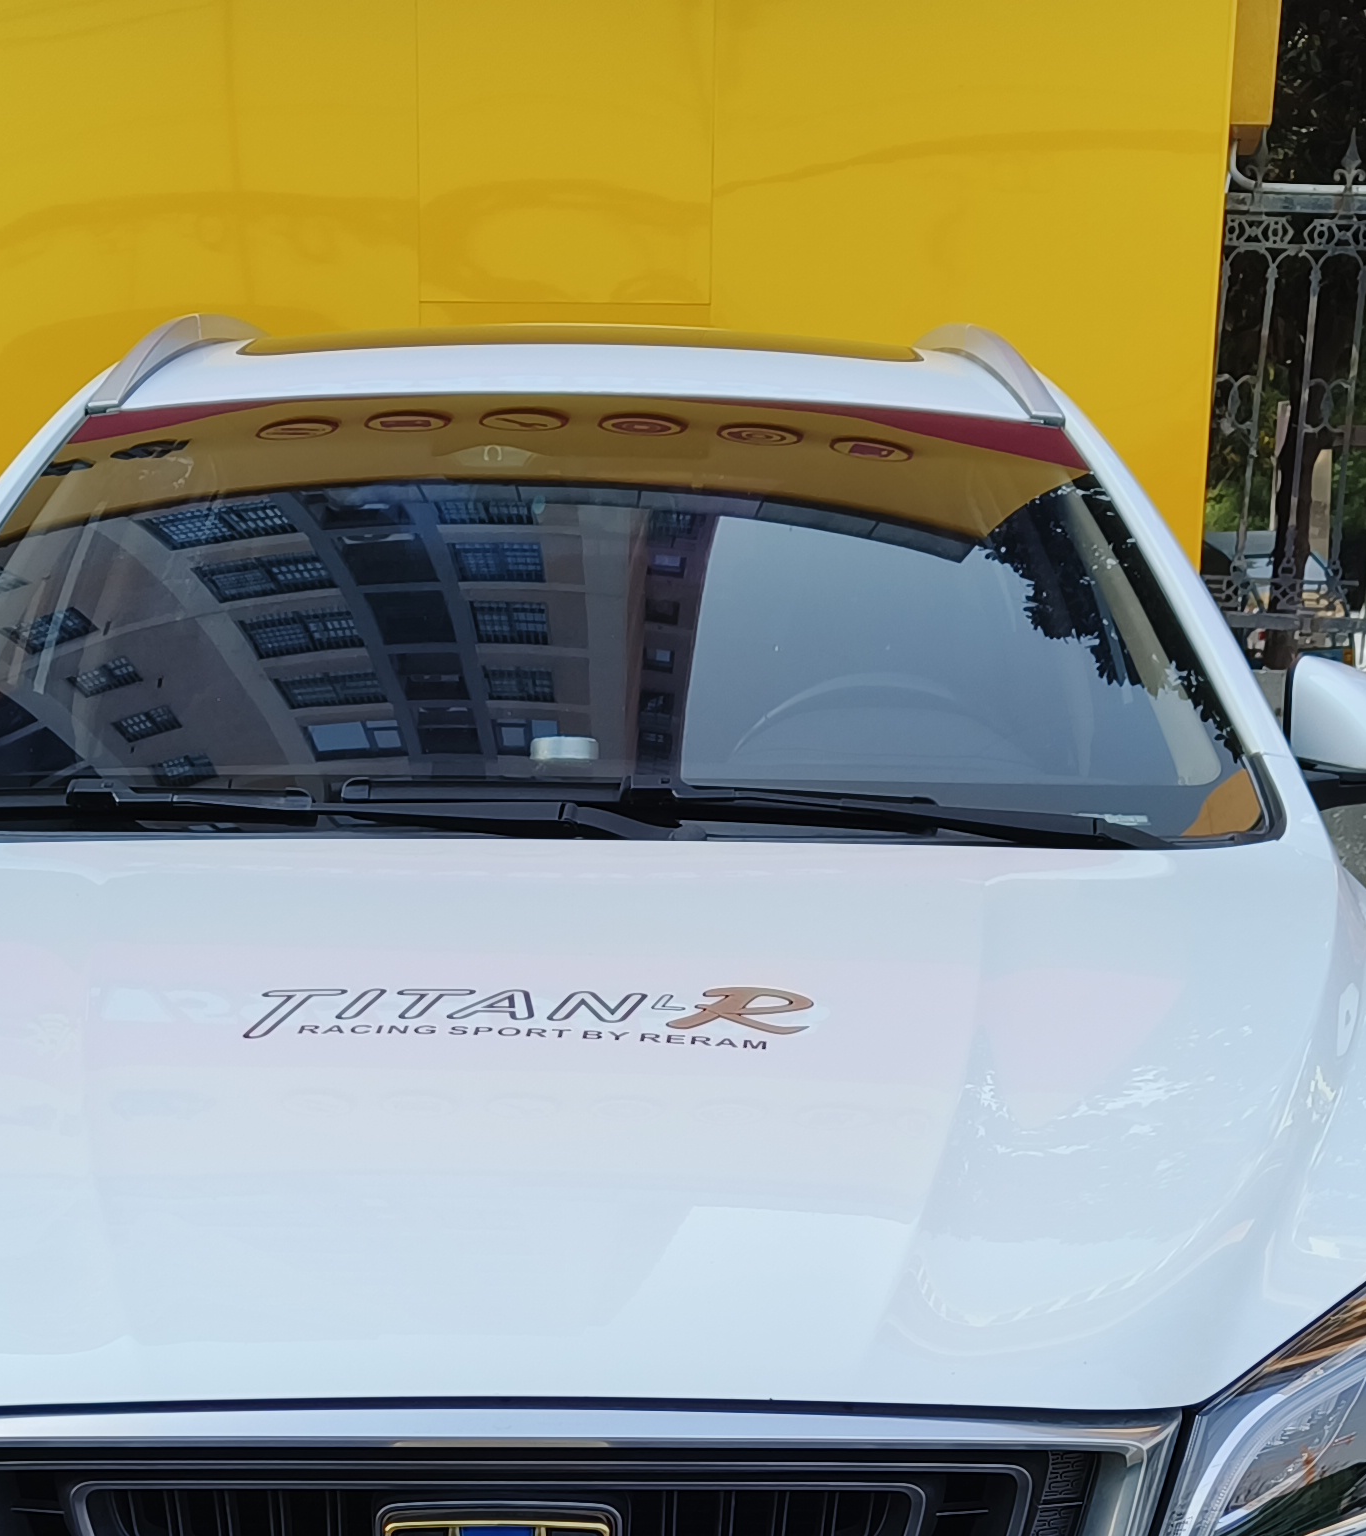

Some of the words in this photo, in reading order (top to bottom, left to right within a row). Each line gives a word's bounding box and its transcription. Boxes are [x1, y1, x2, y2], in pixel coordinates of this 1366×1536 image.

[242, 987, 648, 1039] TITAN
[297, 1023, 437, 1036] RACING
[447, 1024, 572, 1040] SPORT
[581, 1029, 625, 1043] BY
[638, 1032, 769, 1051] RERAM
